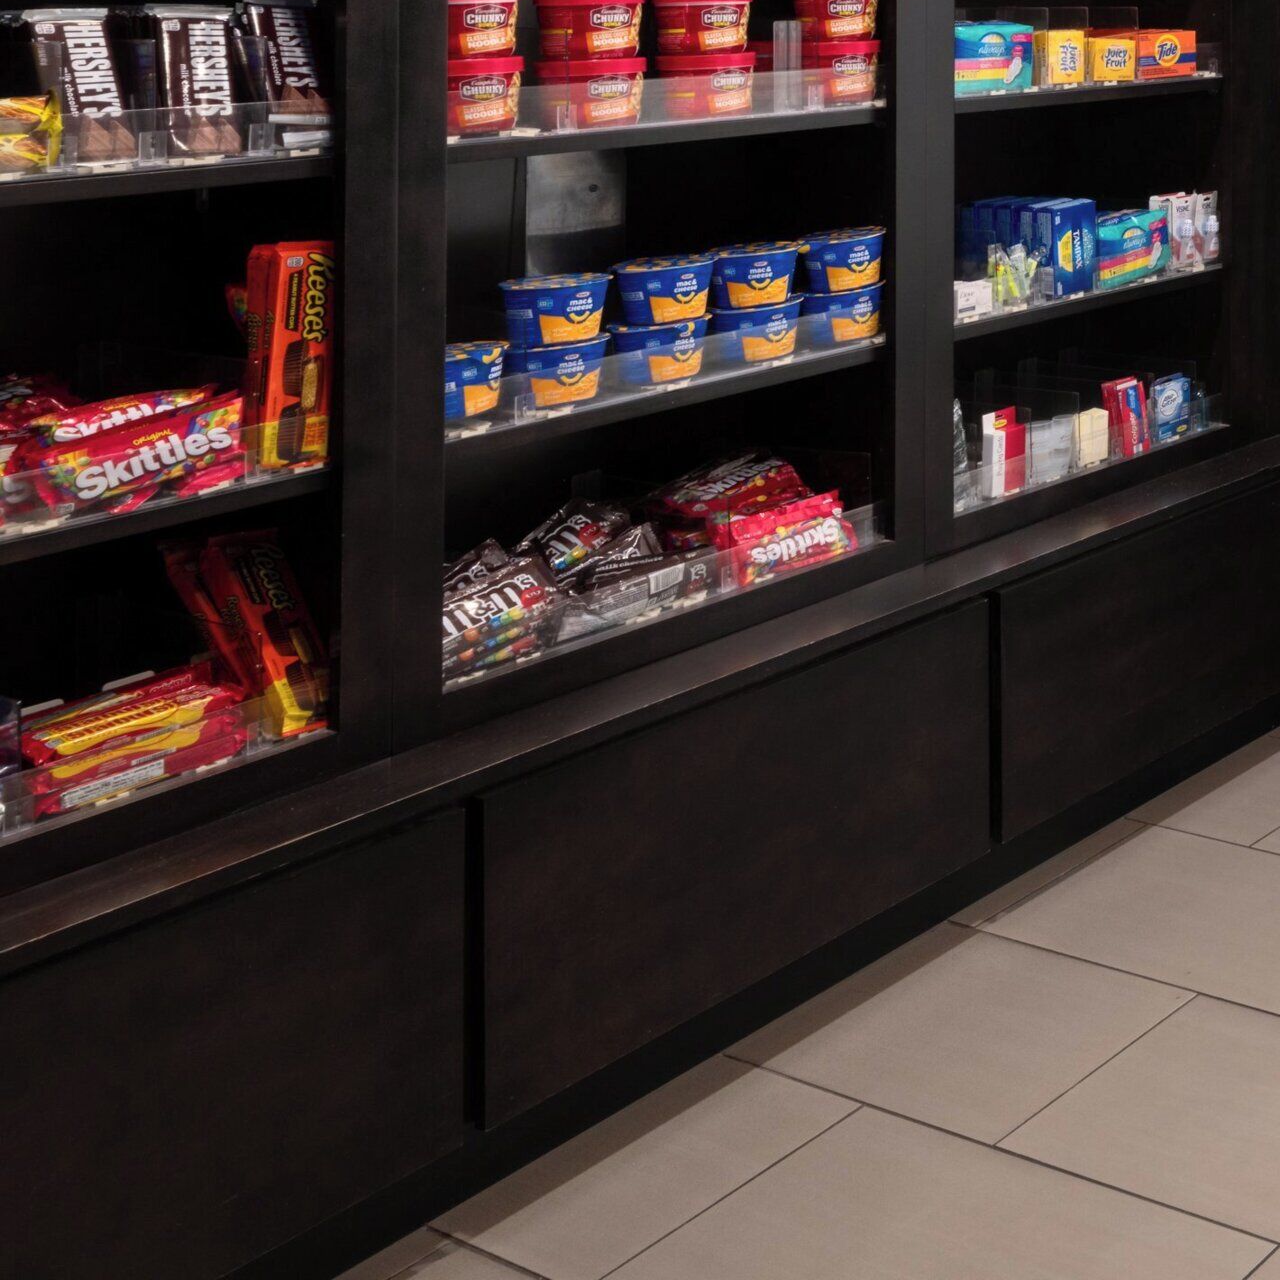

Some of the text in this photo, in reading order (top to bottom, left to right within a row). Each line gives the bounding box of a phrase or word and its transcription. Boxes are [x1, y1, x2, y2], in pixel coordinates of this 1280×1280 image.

[830, 3, 863, 13] CHUNKY
[466, 14, 506, 24] CHUNKY
[593, 13, 630, 23] CHUNKY
[704, 14, 738, 24] CHUNKY
[1068, 42, 1078, 72] Juicy
[1104, 48, 1128, 60] Juicy
[1157, 42, 1178, 61] Tide
[1059, 43, 1069, 72] Fruit
[835, 62, 867, 71] CHUNKY
[1105, 59, 1127, 68] Fruit
[63, 25, 123, 118] HERSHEY'S
[188, 23, 233, 116] HERSHEY'S
[713, 77, 746, 87] CHUNKY
[462, 85, 504, 95] CHUNKY
[590, 84, 629, 94] CHUNKY
[1073, 230, 1083, 269] TAMPAX
[490, 363, 502, 372] mac
[1130, 412, 1138, 444] Colgate
[75, 426, 232, 501] Skittles
[751, 519, 842, 564] Skittles
